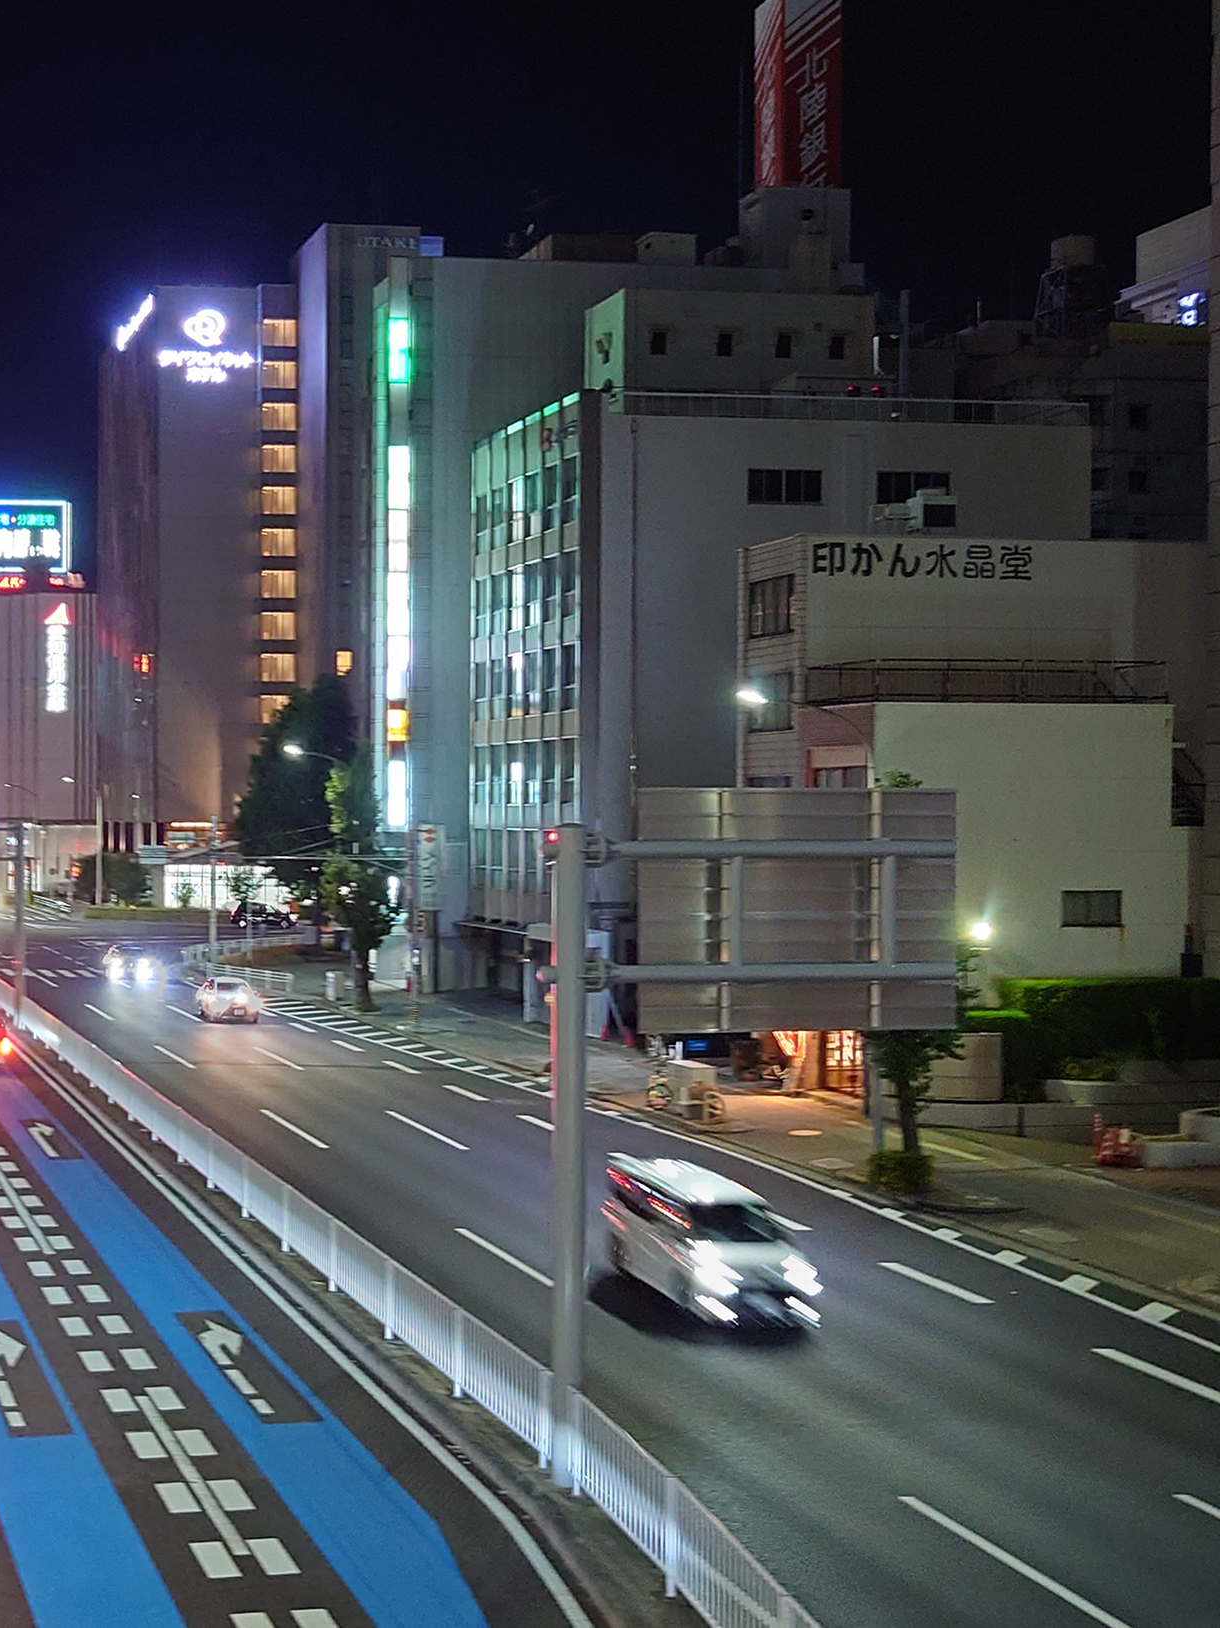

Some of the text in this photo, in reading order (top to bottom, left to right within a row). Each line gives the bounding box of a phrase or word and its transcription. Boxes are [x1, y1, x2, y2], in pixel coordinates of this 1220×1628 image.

[811, 541, 1034, 581] 印かん水晶堂
